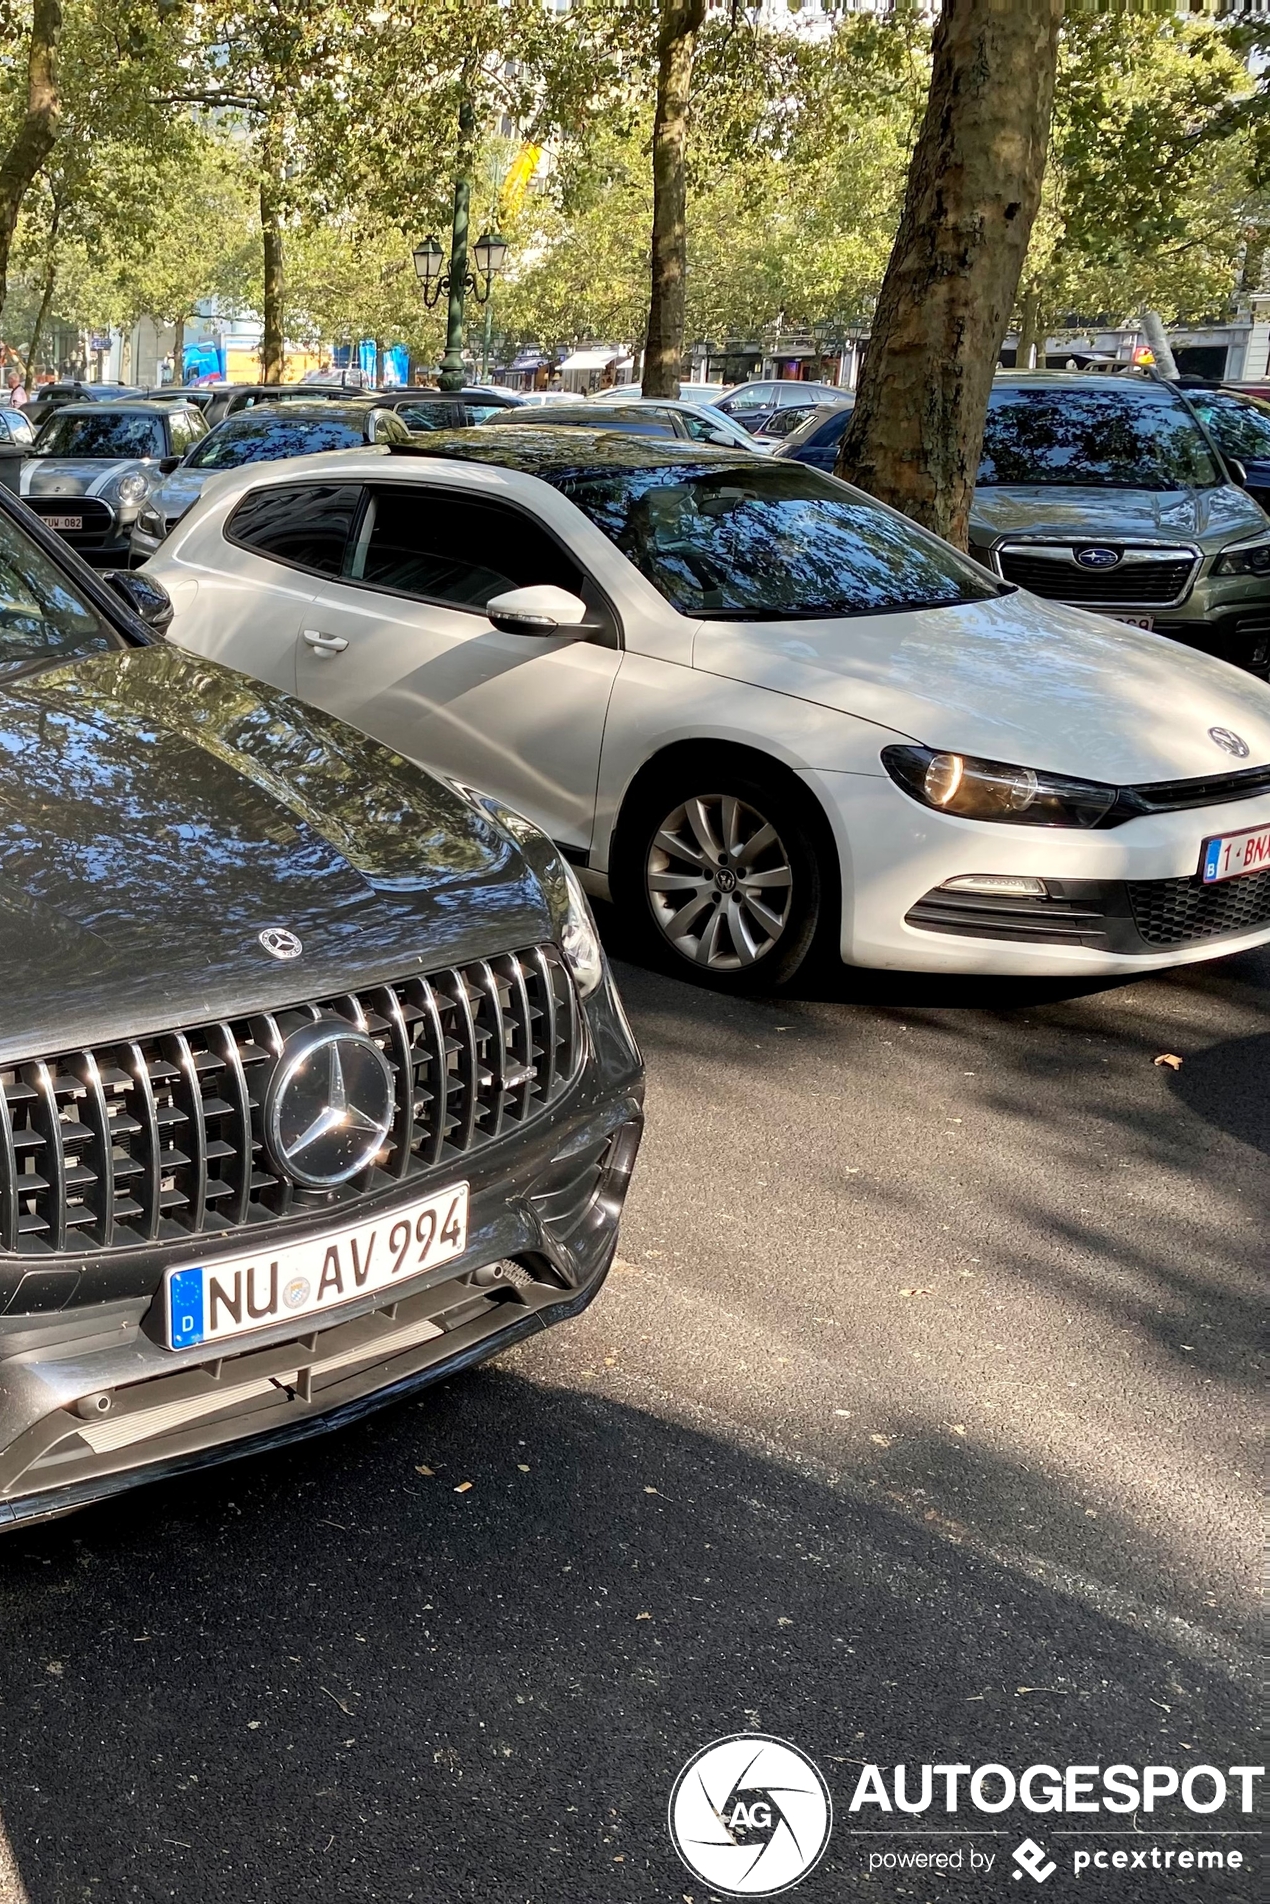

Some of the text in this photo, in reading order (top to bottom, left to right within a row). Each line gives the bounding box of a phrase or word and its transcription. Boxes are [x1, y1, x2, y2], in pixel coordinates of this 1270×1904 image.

[1207, 863, 1215, 877] B
[209, 1196, 461, 1331] NU AV 994
[182, 1316, 194, 1332] D
